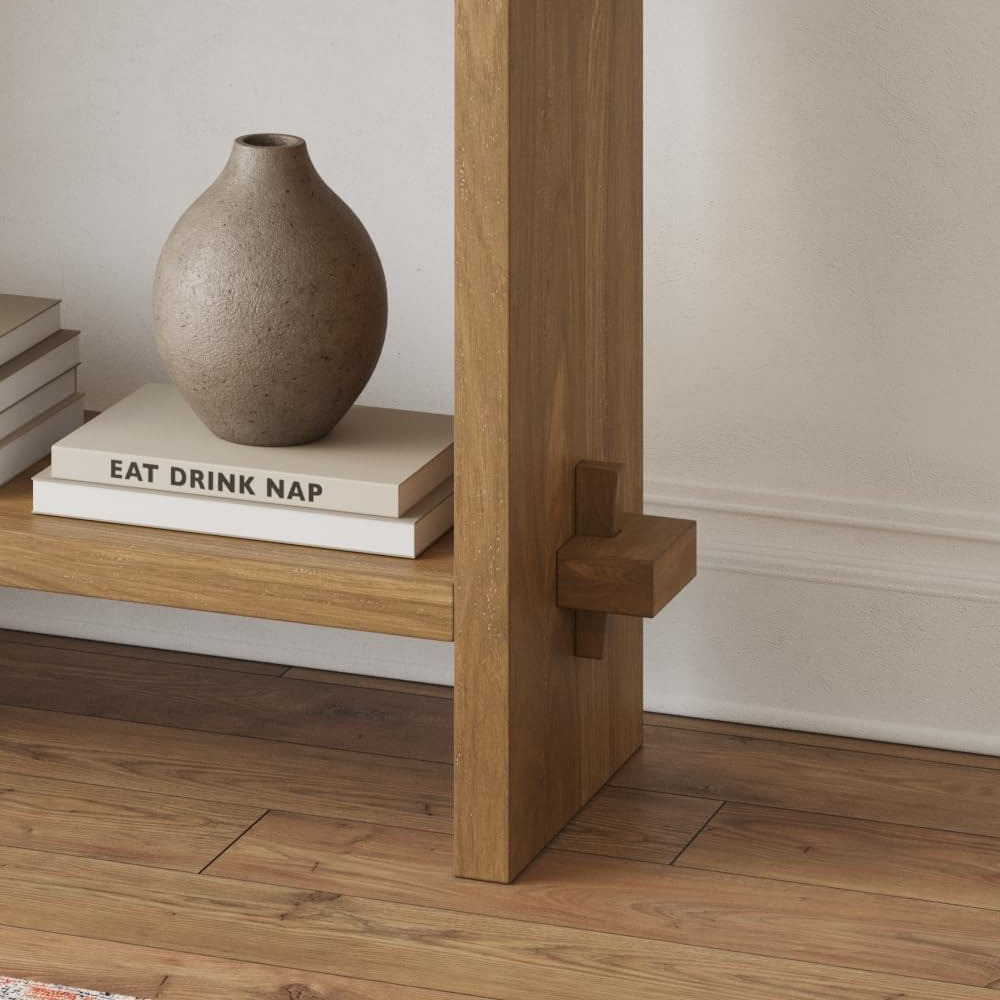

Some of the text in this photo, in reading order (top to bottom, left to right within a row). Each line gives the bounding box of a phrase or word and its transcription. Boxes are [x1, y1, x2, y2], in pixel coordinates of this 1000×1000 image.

[110, 459, 323, 502] EAT DRINK NAP
